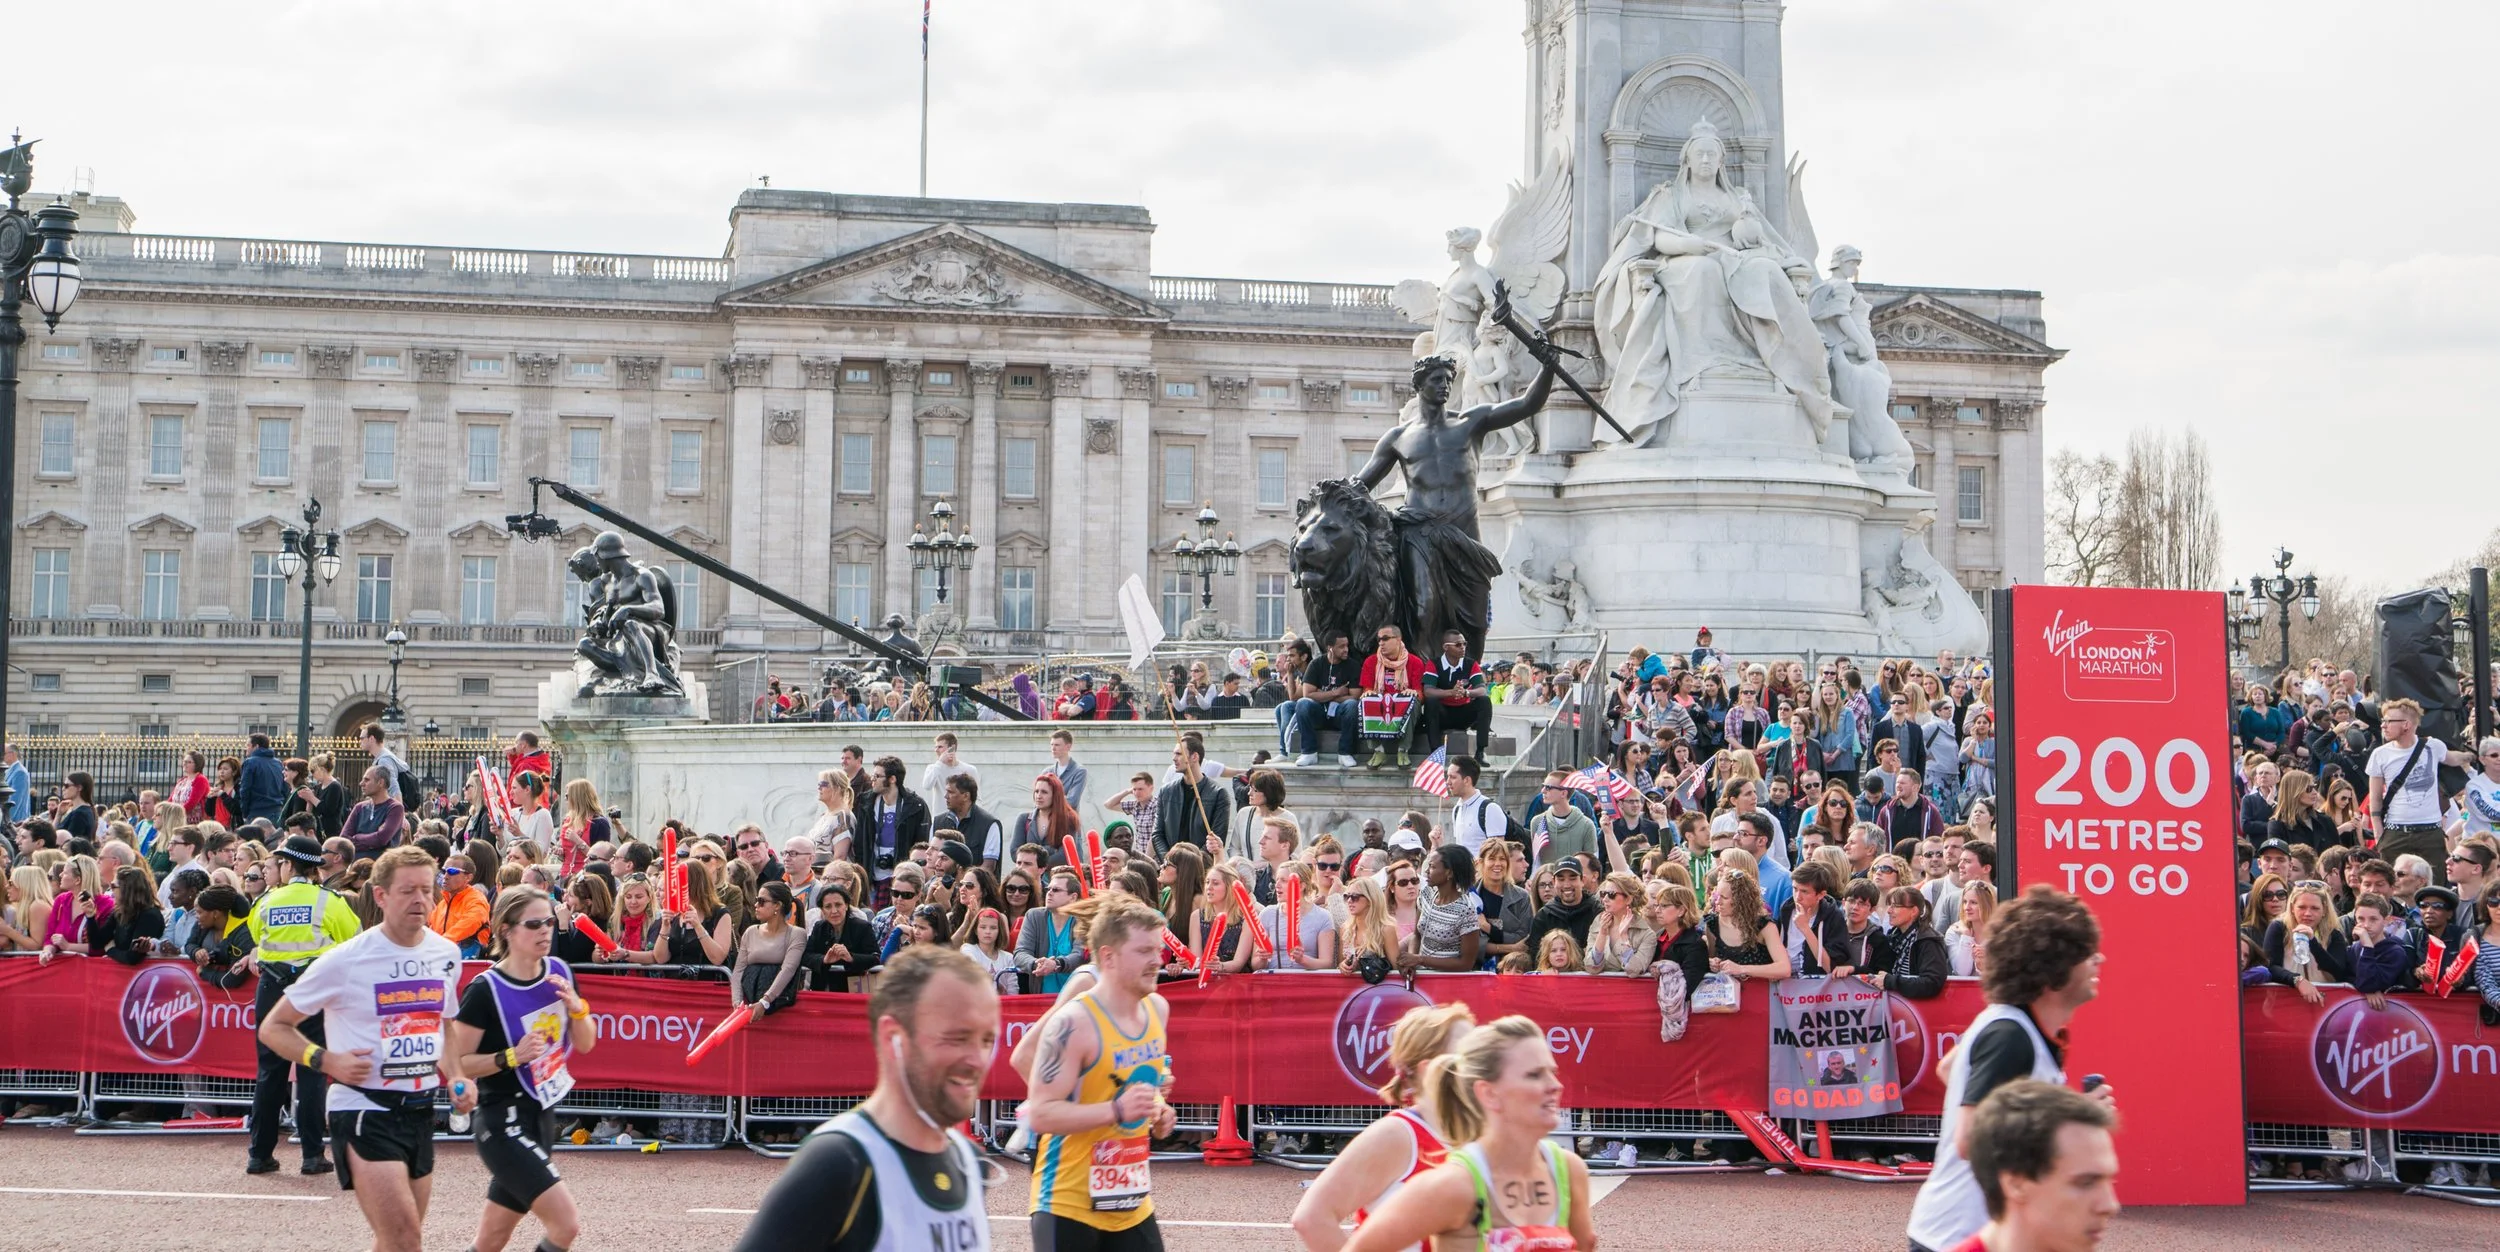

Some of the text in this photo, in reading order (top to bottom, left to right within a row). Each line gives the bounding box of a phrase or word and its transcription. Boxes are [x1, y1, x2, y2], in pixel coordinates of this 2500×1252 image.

[2043, 609, 2094, 659] Virgin
[2079, 646, 2142, 660] LONDON
[2079, 660, 2163, 675] MARATHON
[2035, 735, 2211, 808] 200
[2044, 818, 2203, 852] METRES
[1093, 856, 1106, 890] TIME
[2059, 863, 2189, 896] TO GO
[271, 912, 310, 924] POLICE
[389, 960, 432, 978] JON
[129, 975, 198, 1049] Virgin
[1799, 994, 1833, 1004] DOING
[1838, 993, 1849, 1001] IT
[1799, 1009, 1867, 1030] ANDY
[390, 1036, 434, 1058] 2046
[2326, 1010, 2429, 1099] Virgin
[1774, 1082, 1899, 1109] GO DAD GO
[1754, 1111, 1795, 1157] TIMEX
[1503, 1181, 1552, 1209] SUE
